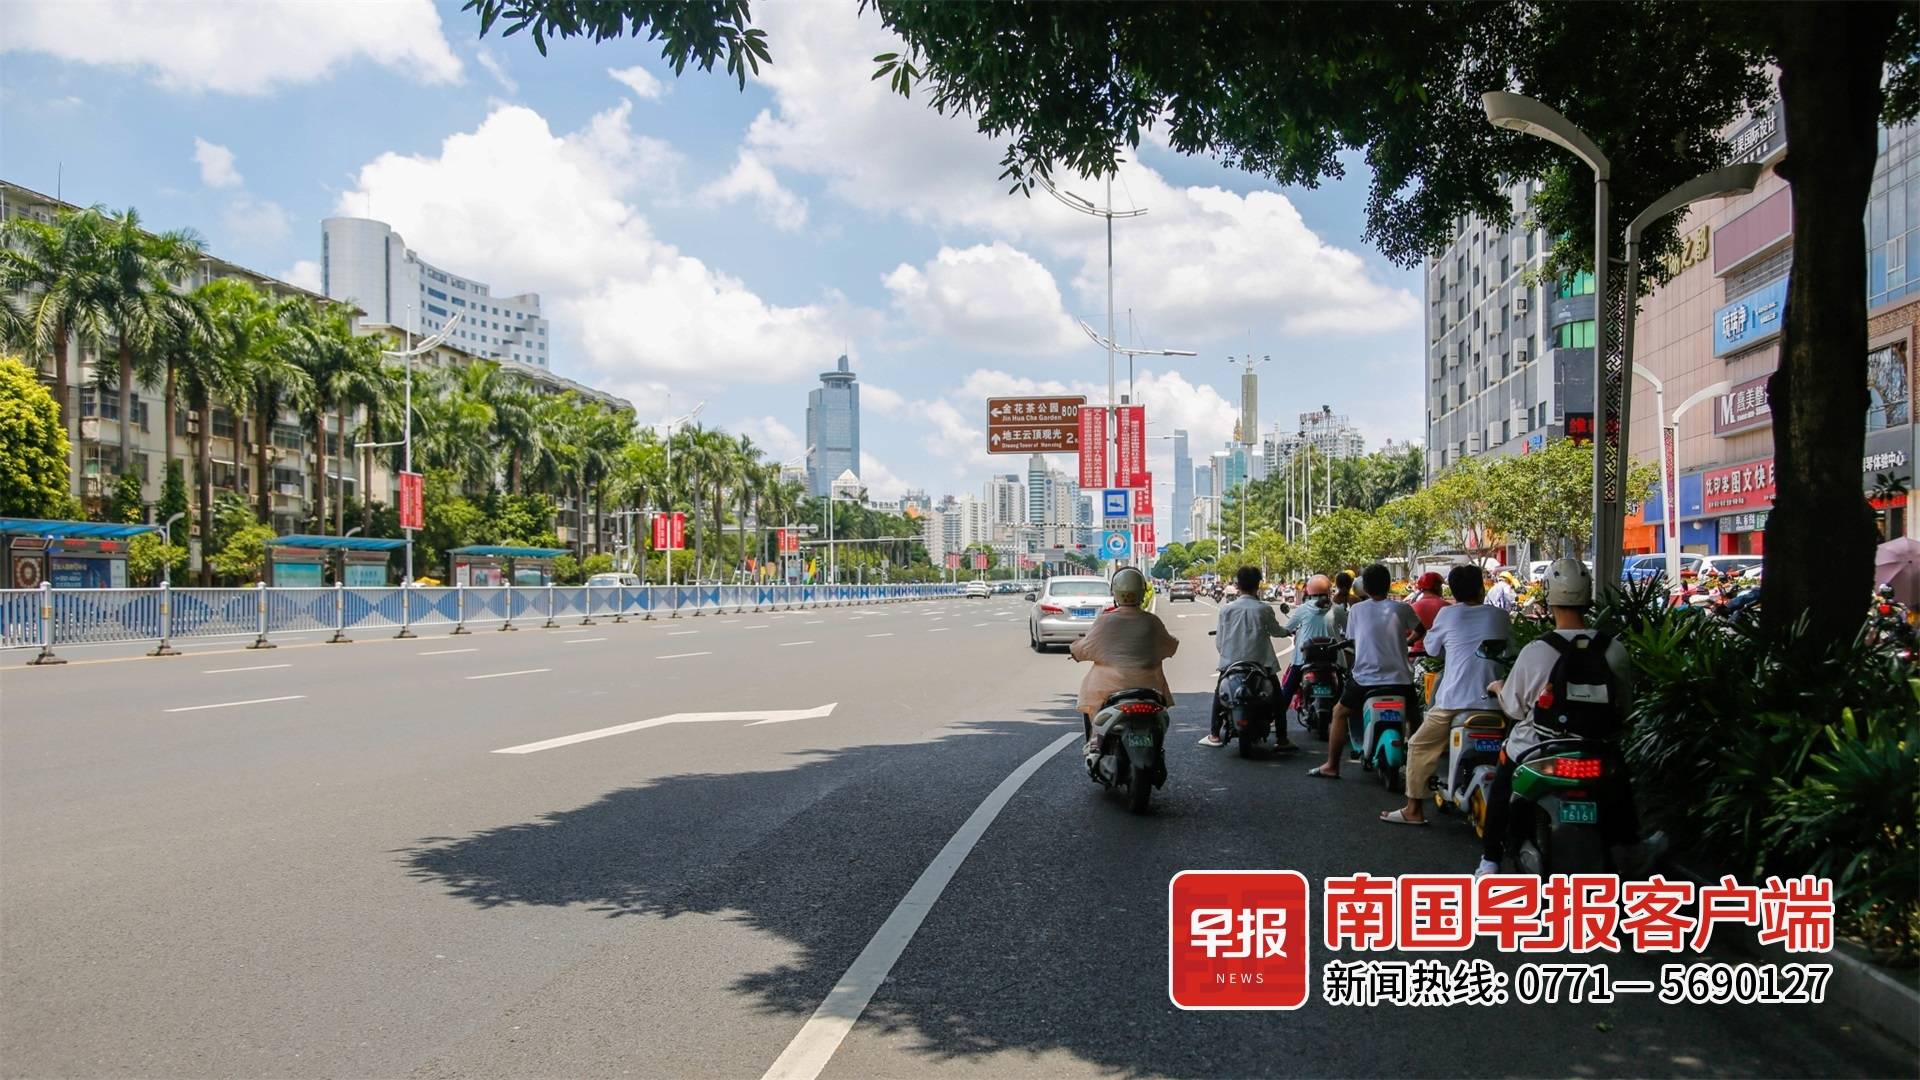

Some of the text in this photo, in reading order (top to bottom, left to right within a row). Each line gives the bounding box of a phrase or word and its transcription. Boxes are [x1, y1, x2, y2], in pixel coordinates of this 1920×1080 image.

[1002, 402, 1078, 417] 金花茶公园 800
[1002, 429, 1062, 441] 地王云顶观光
